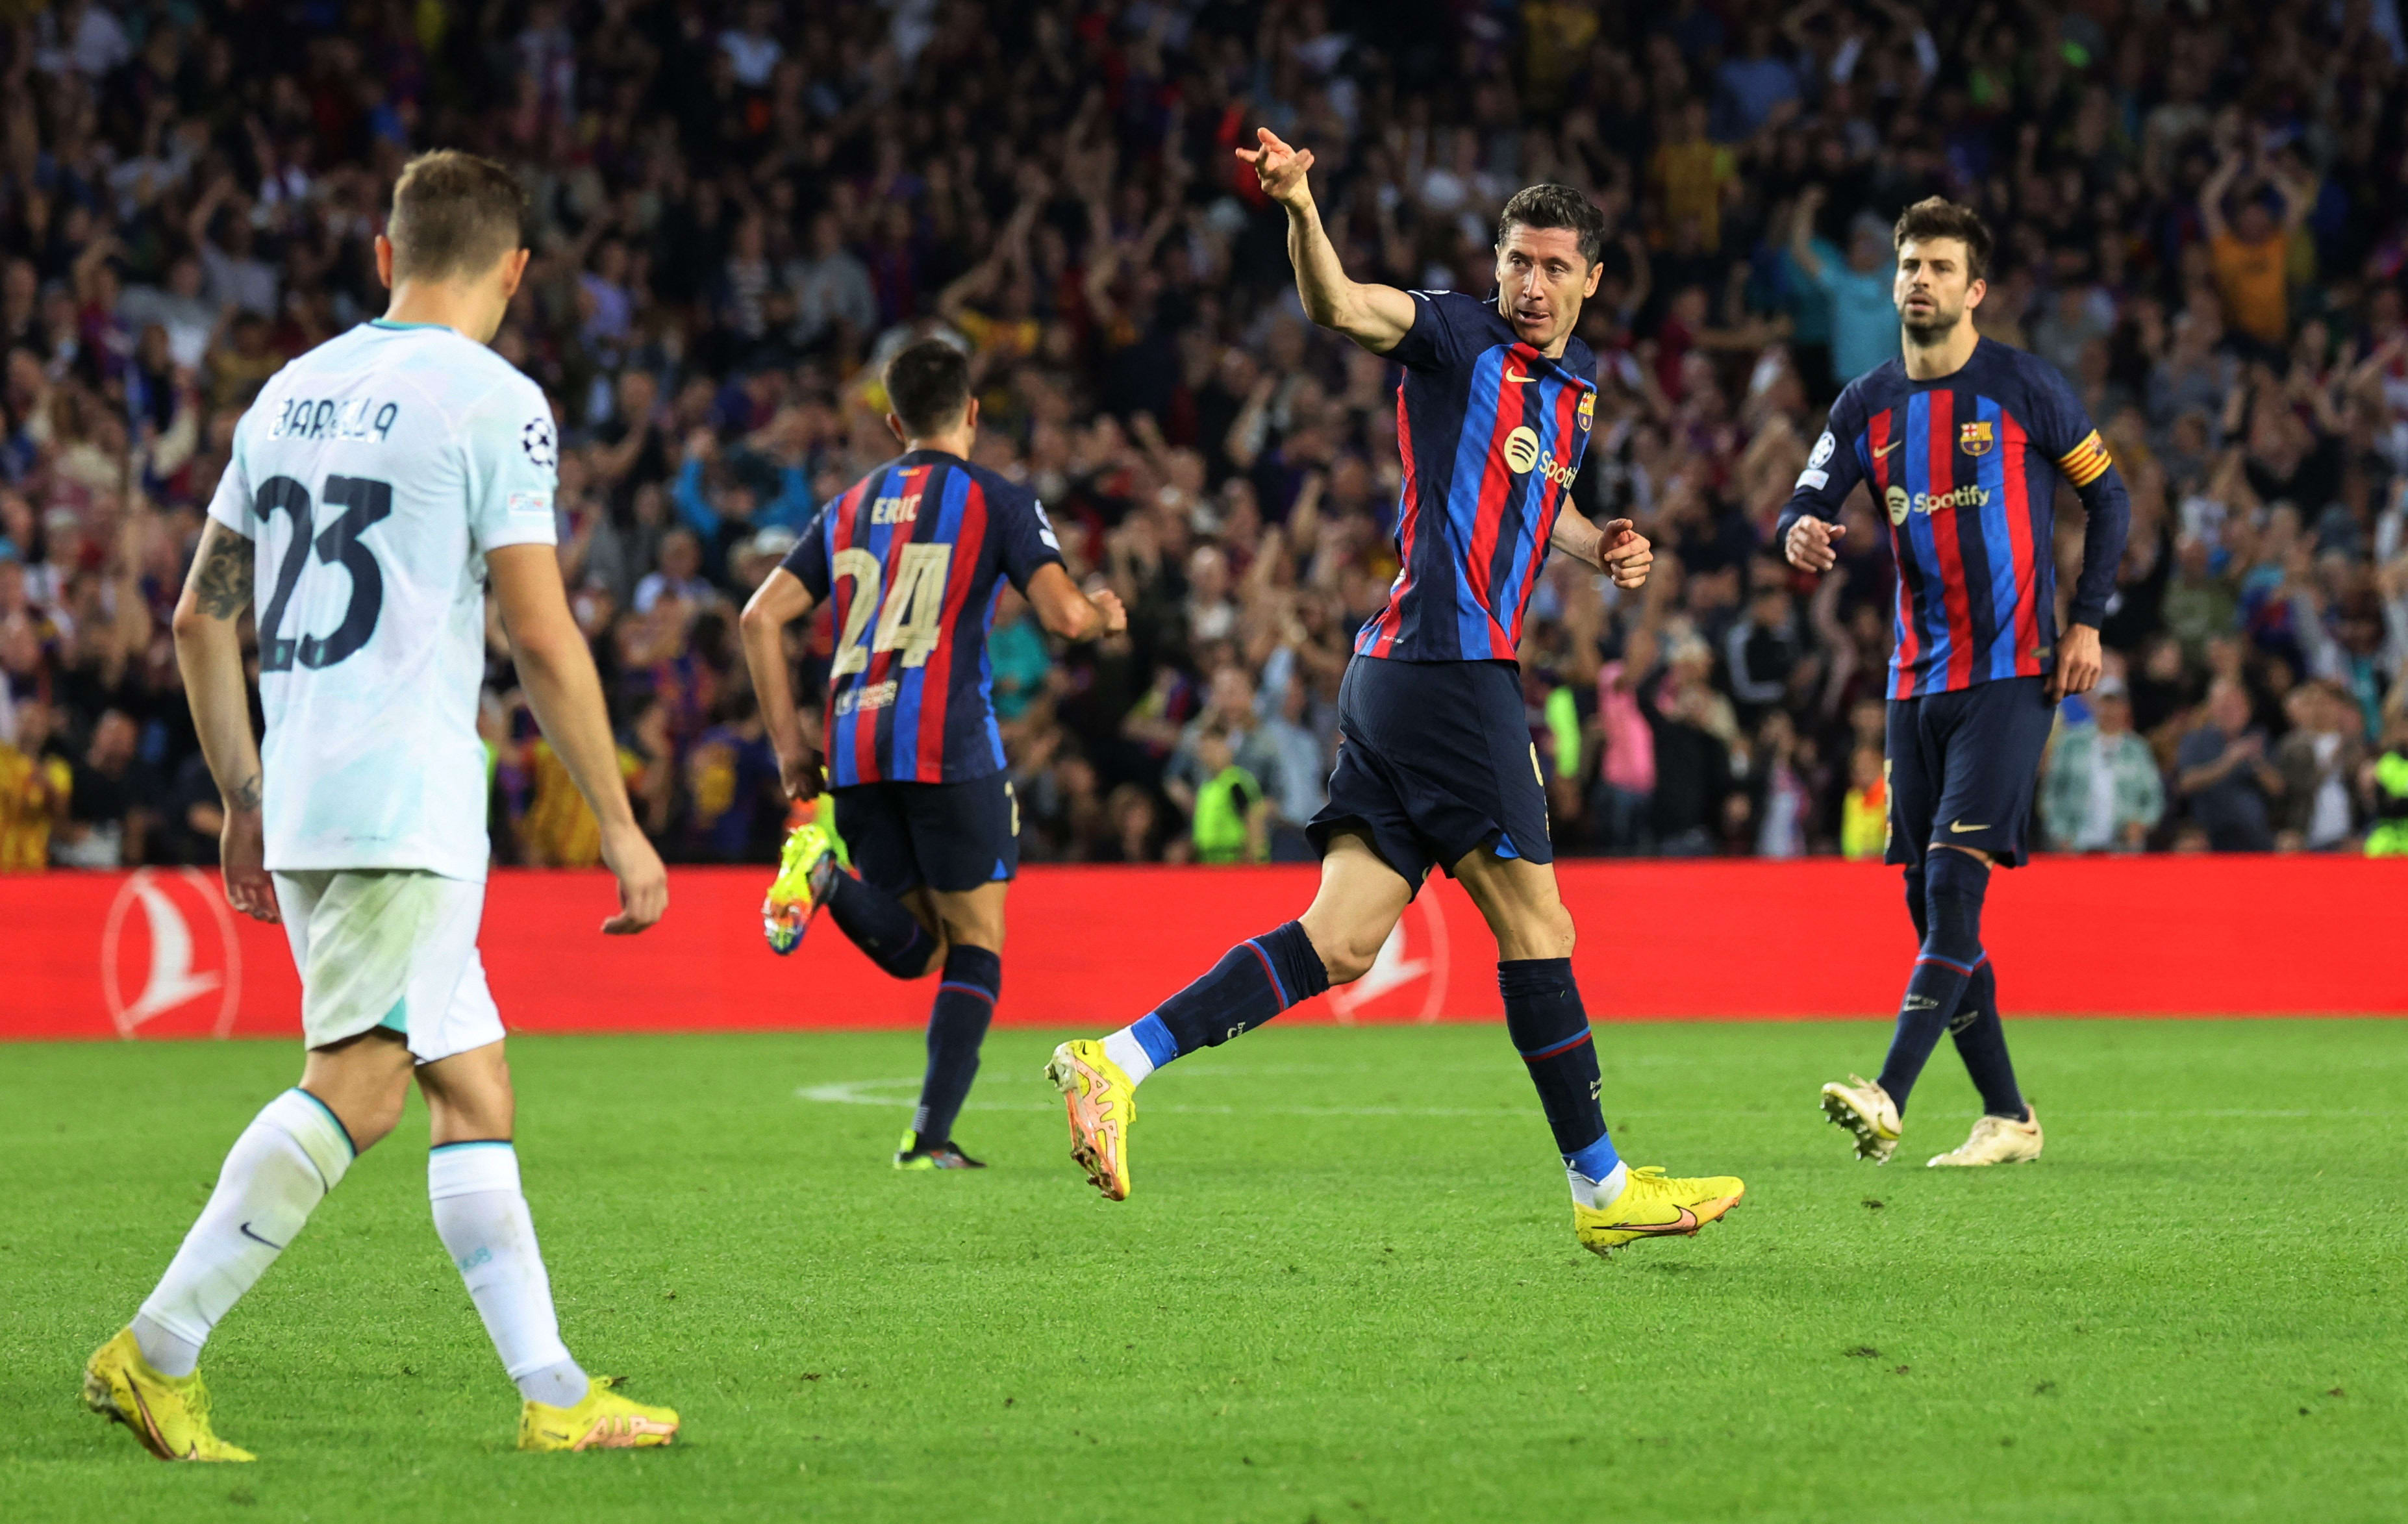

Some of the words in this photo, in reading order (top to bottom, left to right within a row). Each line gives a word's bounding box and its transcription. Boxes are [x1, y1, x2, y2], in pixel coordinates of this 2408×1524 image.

[268, 397, 398, 443] BARLA
[1538, 450, 1578, 492] Spoti
[871, 493, 922, 525] ERIC
[1913, 484, 1990, 516] Spotify
[255, 474, 393, 673] 23
[831, 543, 952, 680] 24
